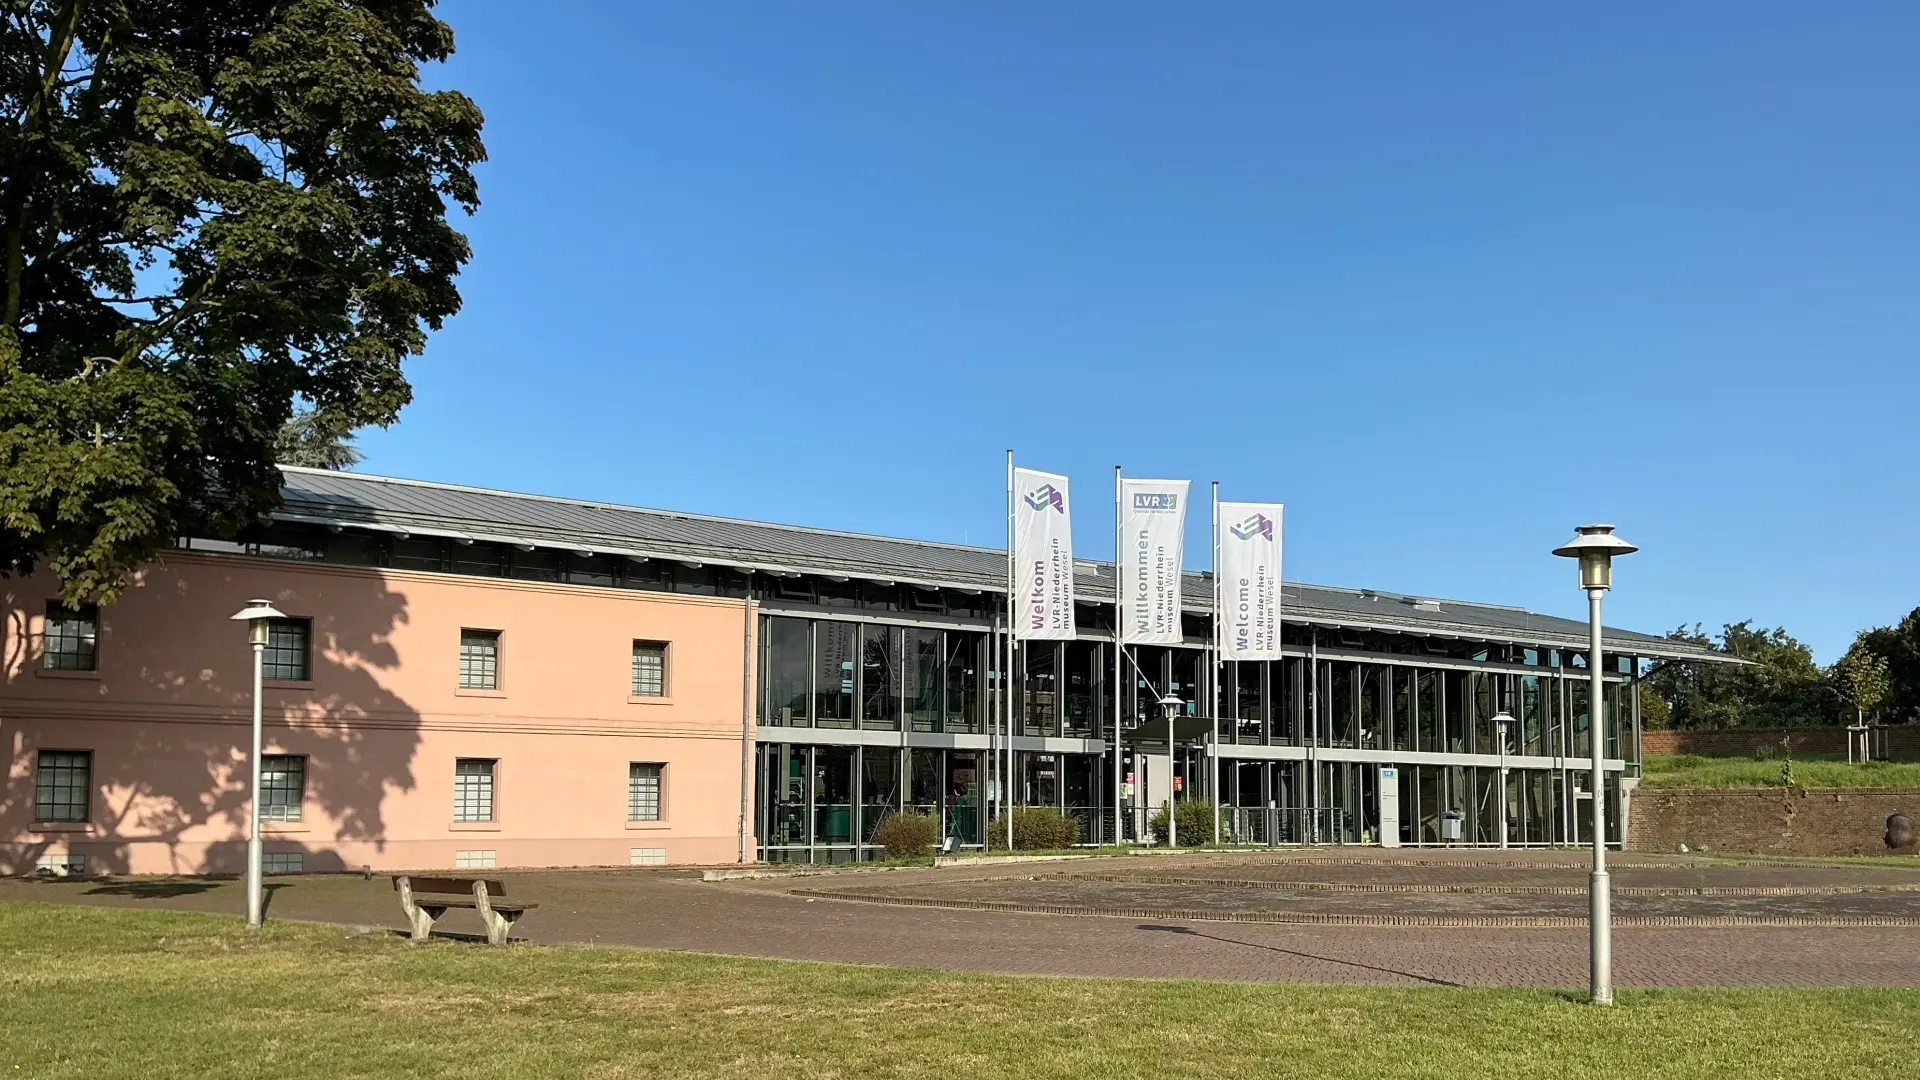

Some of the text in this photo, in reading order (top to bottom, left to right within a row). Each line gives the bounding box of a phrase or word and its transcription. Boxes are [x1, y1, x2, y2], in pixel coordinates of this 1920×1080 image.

[1136, 495, 1160, 506] LVR
[1031, 560, 1045, 630] Welkom
[1051, 538, 1061, 630] LVR-Niederrhein
[1062, 583, 1070, 630] museum
[1136, 529, 1149, 635] Willkommen
[1156, 545, 1165, 634] LVR-Niederrhein
[1166, 557, 1174, 633] museum Wesel
[1236, 578, 1249, 652] Welcome
[1255, 565, 1265, 651] LVR-Niederrhein
[1266, 576, 1274, 651] museum Wesel
